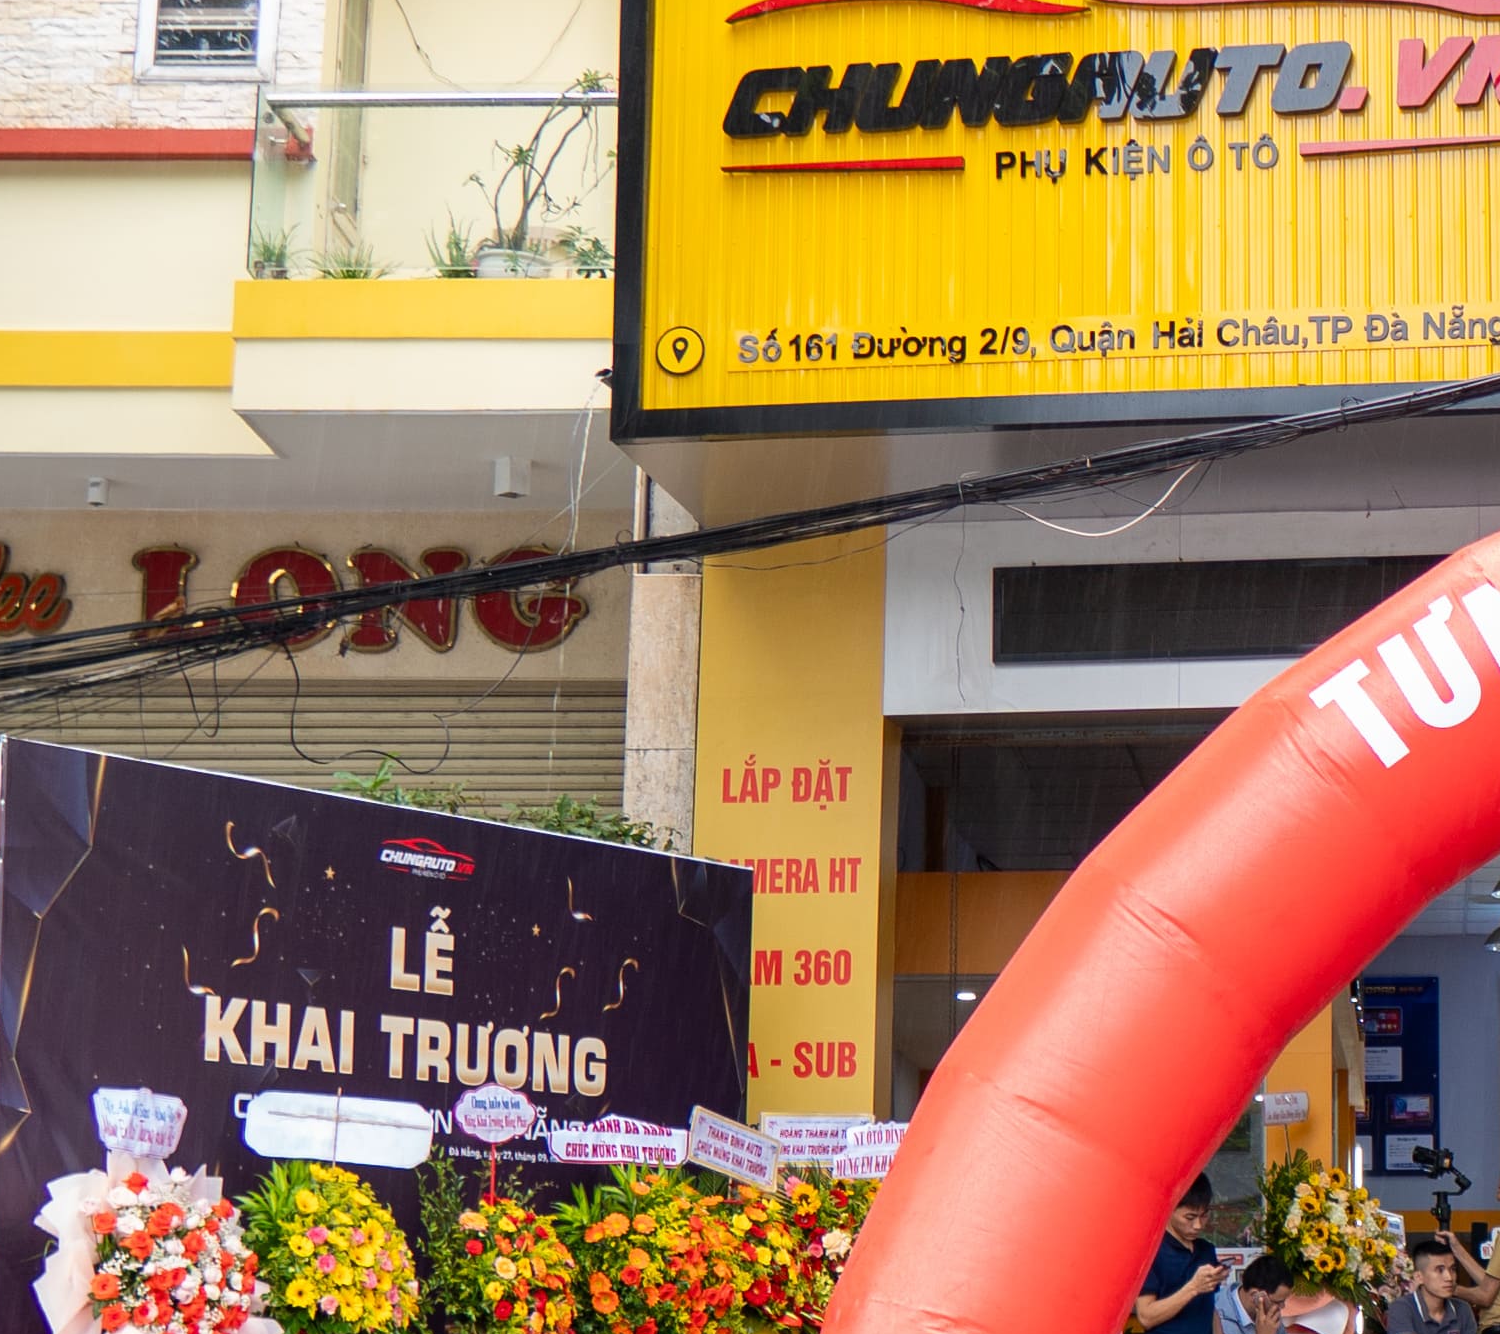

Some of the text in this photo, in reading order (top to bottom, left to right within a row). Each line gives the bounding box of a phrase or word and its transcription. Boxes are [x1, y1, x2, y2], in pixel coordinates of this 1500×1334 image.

[996, 133, 1279, 183] PHỤ KIỆN Ô TÔ
[738, 328, 781, 363] Số
[789, 333, 838, 361] 161
[851, 326, 967, 364] Đường
[980, 326, 1037, 359] 2/9,
[1049, 321, 1135, 358] Quận
[1153, 317, 1203, 349] Hải
[1364, 312, 1408, 343] Đà
[130, 542, 588, 654] LONG
[722, 754, 852, 810] LẮP ĐẶT
[715, 858, 861, 893] MERA HT
[390, 906, 455, 996] LỄ
[794, 949, 852, 986] 360
[204, 995, 607, 1097] KHAI TRƯƠNG
[793, 1041, 857, 1079] SUB
